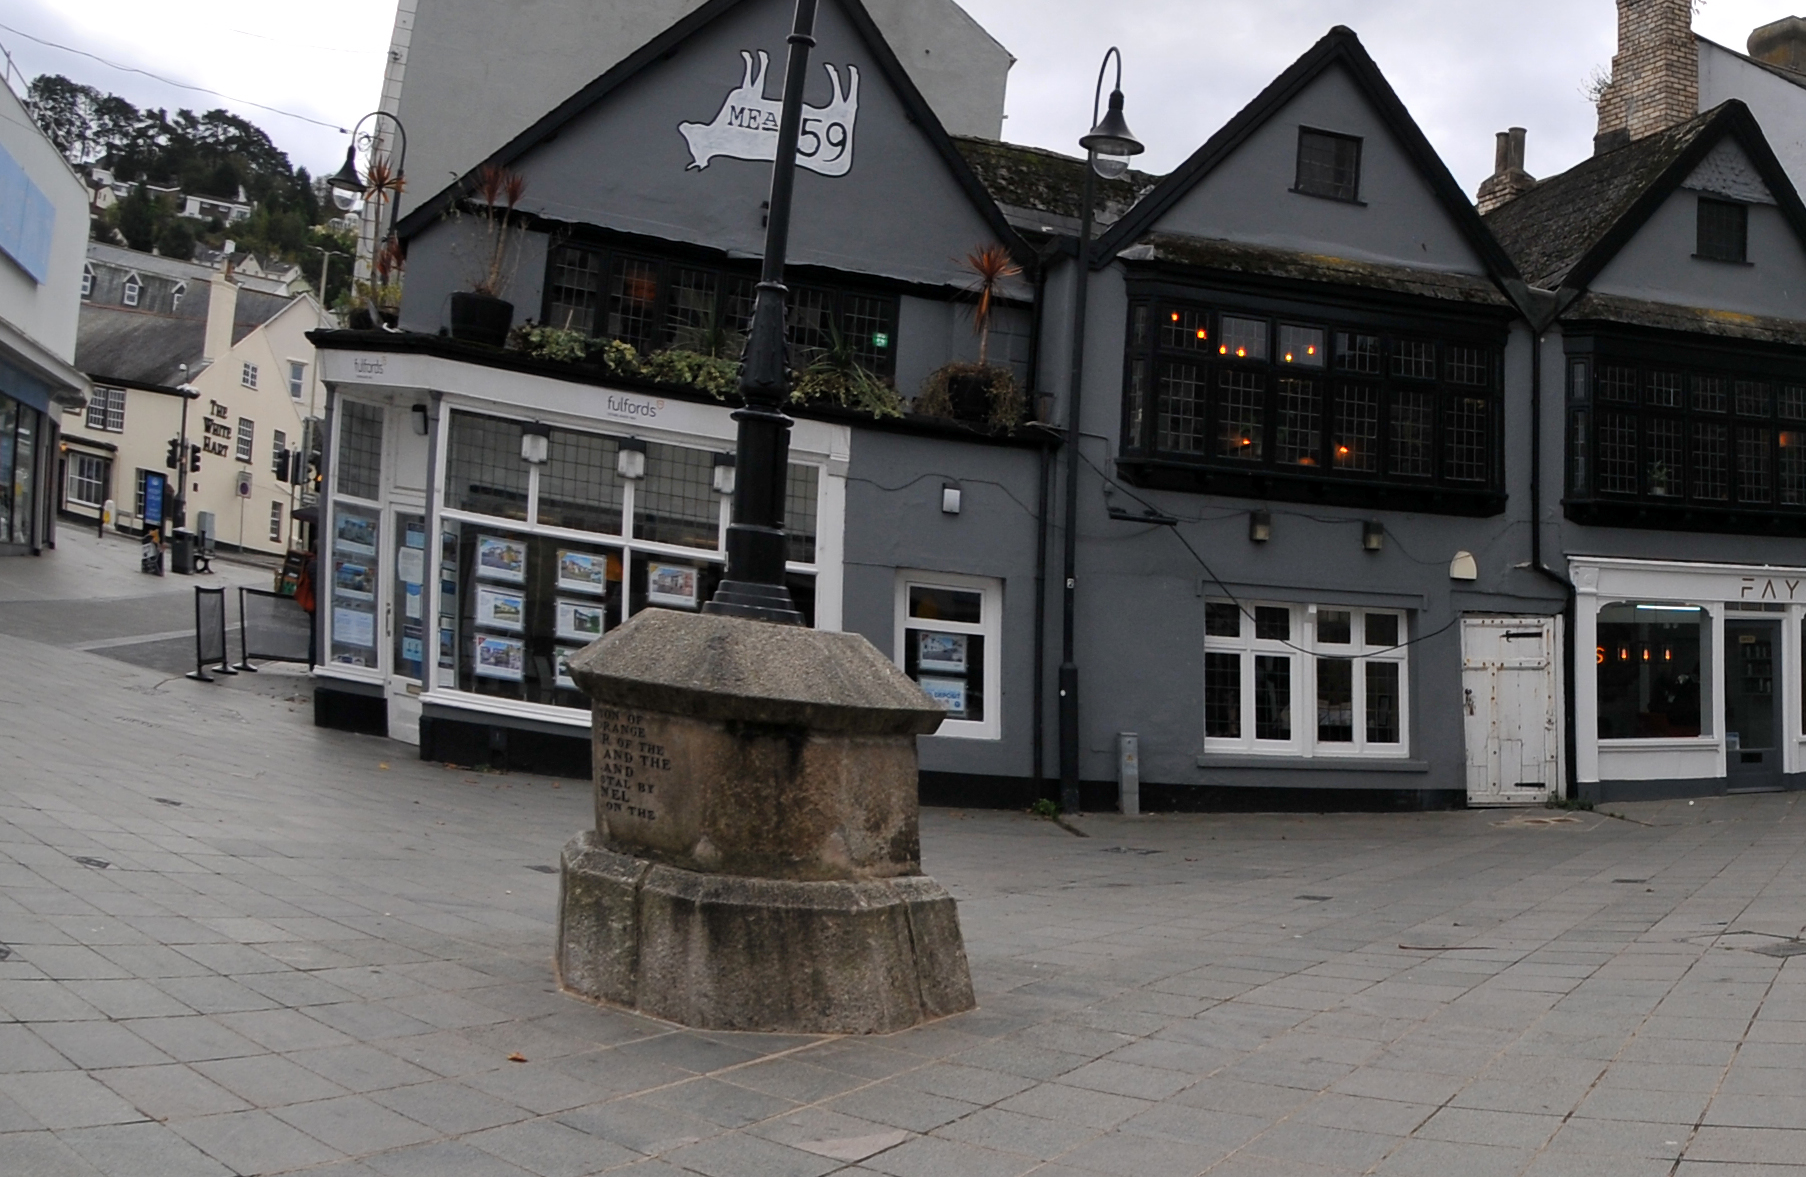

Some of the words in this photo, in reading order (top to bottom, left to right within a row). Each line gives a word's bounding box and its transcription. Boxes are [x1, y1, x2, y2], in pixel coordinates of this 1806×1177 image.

[727, 105, 779, 131] MEA
[797, 117, 847, 162] 59
[210, 399, 228, 419] THE
[607, 395, 657, 418] fulfords
[203, 416, 232, 440] WHITE
[203, 436, 229, 458] HART
[627, 713, 643, 725] OF
[603, 749, 633, 764] AND
[640, 754, 672, 771] THE
[639, 742, 665, 757] THE
[638, 782, 656, 794] BY
[627, 806, 656, 821] THE
